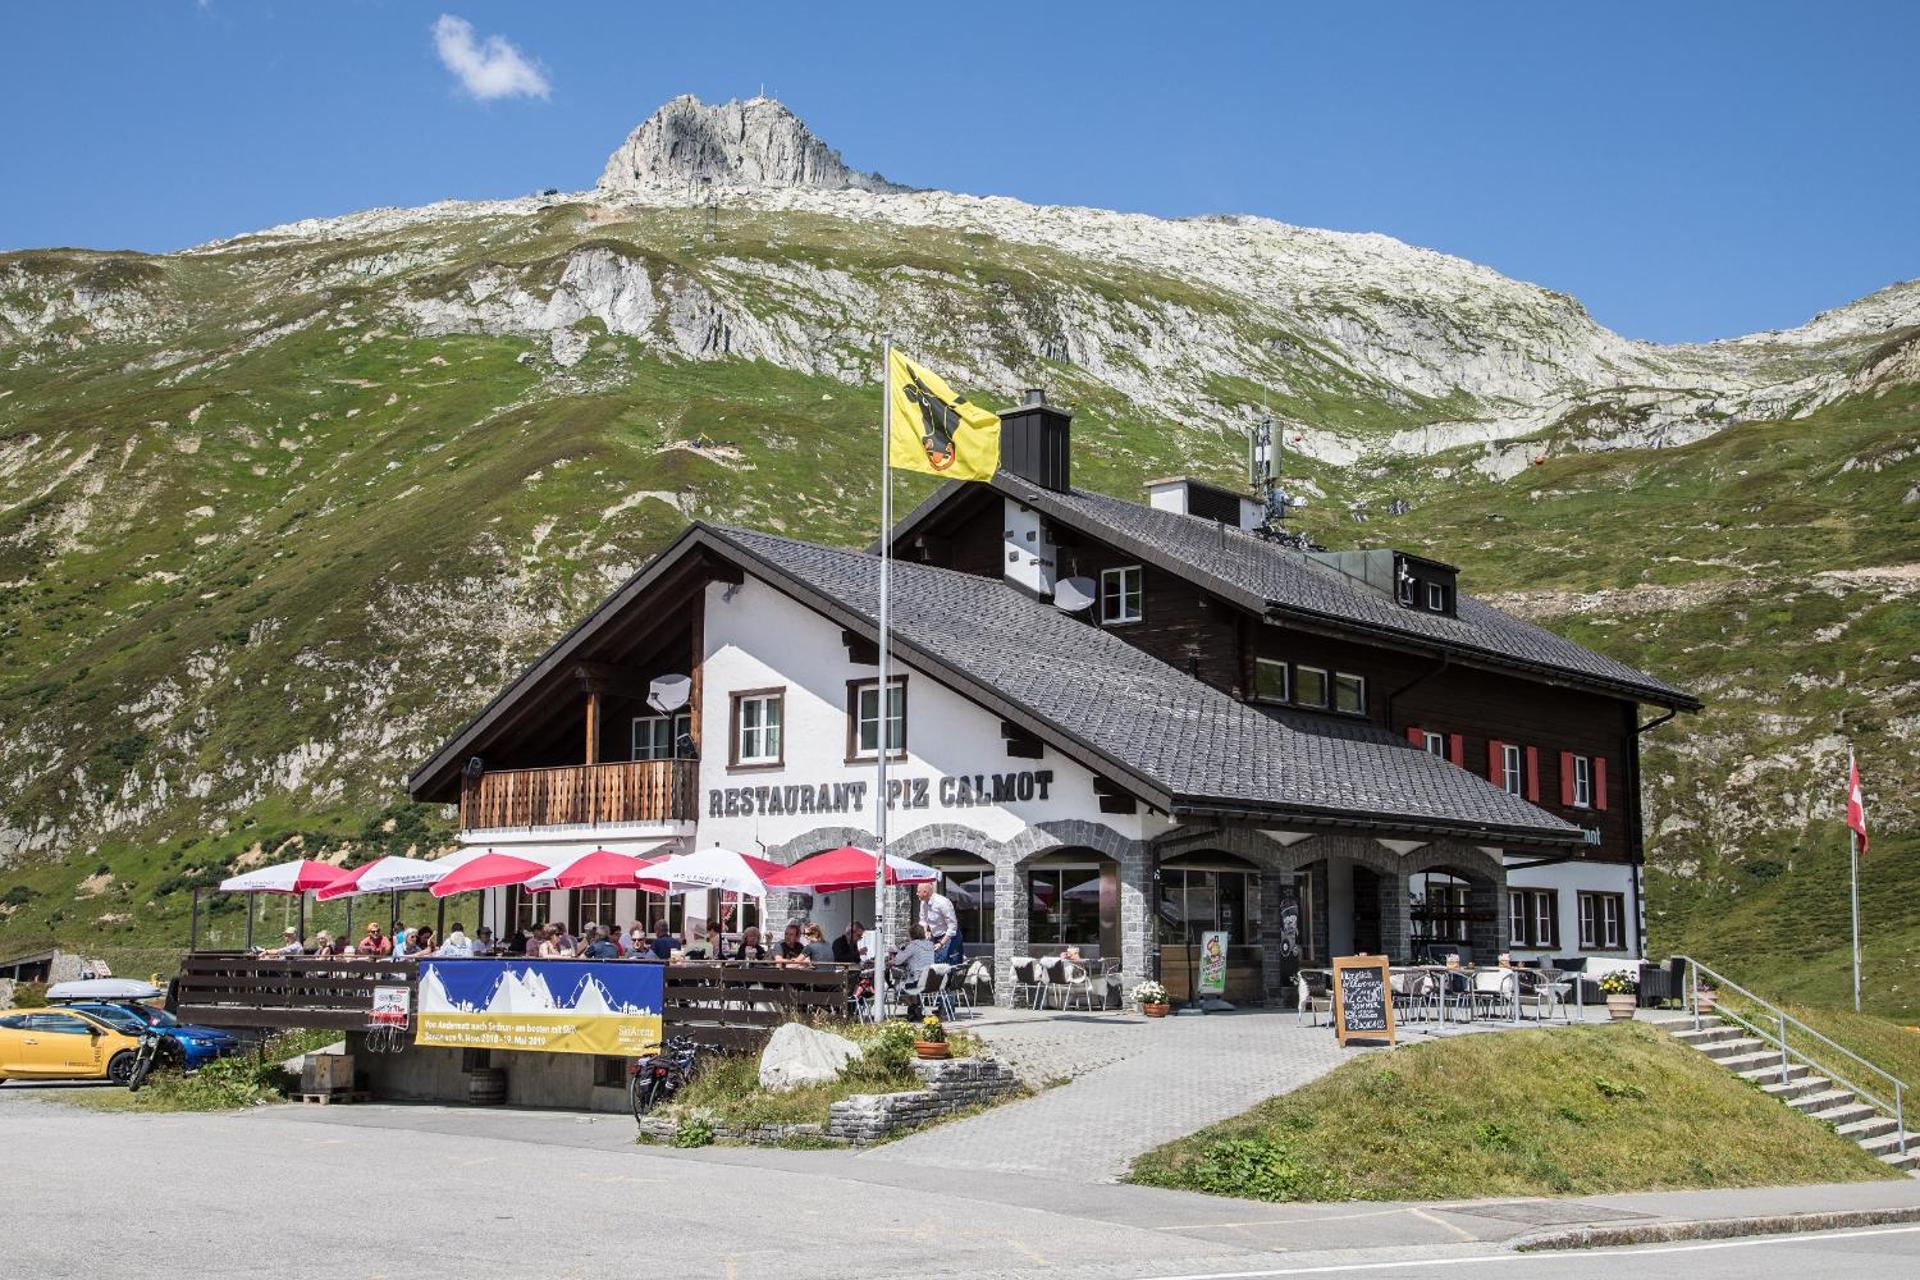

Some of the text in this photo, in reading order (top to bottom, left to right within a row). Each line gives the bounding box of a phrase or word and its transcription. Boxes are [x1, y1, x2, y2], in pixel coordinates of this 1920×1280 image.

[708, 769, 1054, 818] RESTAURANT PIZ CALMOT
